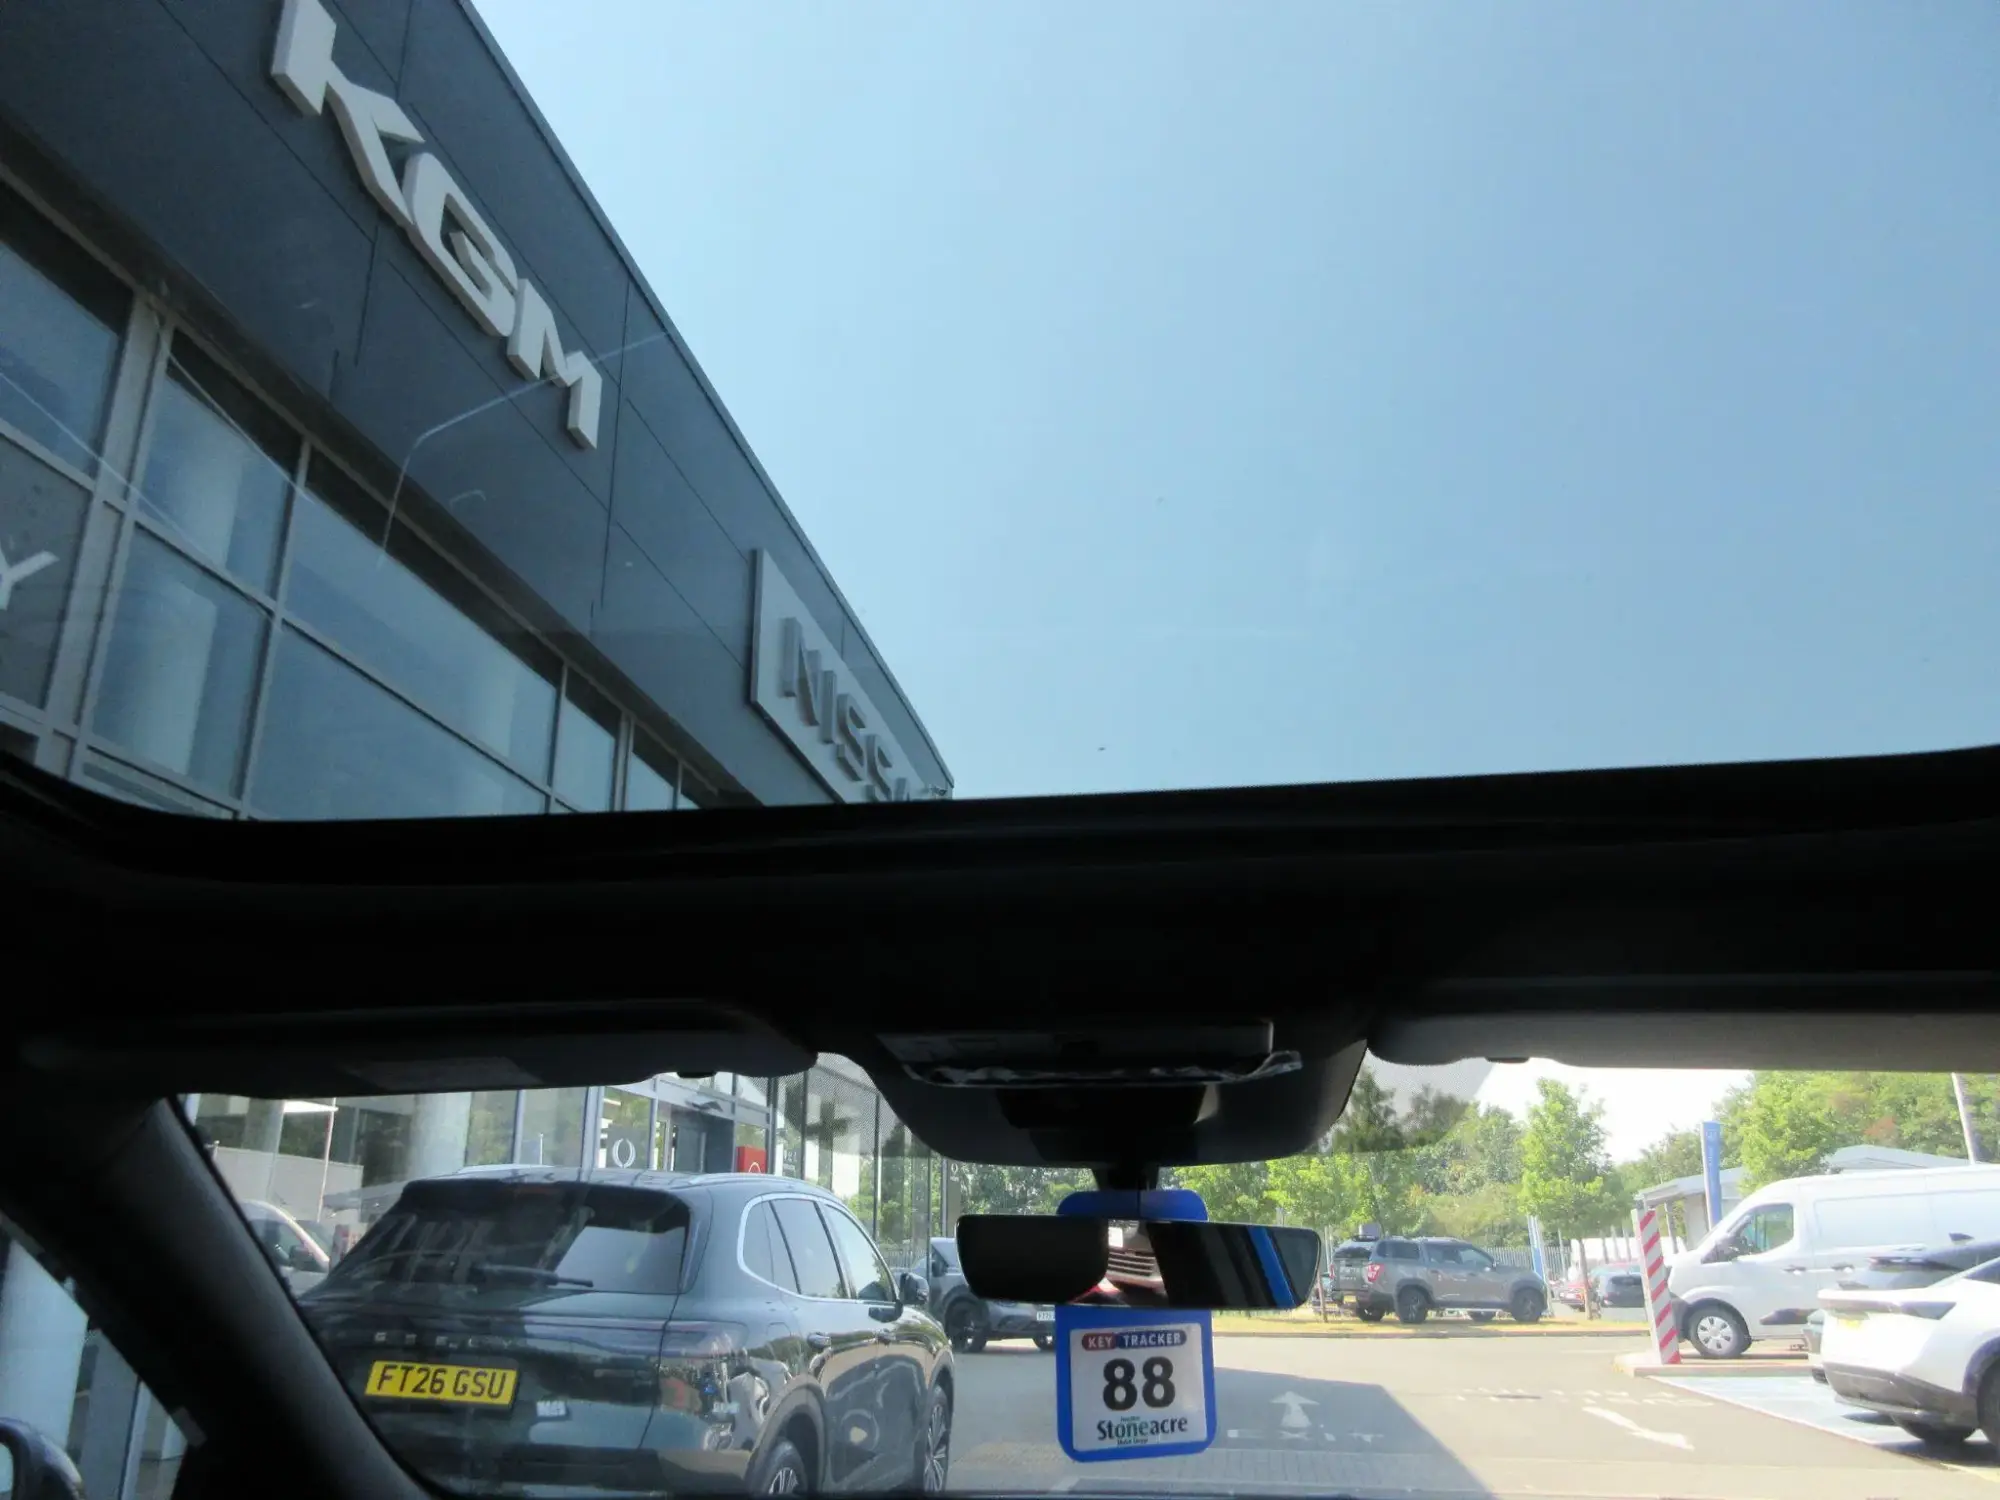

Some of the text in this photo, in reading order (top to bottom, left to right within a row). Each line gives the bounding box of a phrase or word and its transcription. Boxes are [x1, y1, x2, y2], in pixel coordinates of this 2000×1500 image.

[270, 0, 603, 450] KGM
[1088, 1332, 1182, 1348] KEY TRACKER
[376, 1363, 507, 1400] FT26 GSU
[1102, 1356, 1176, 1411] 88
[1096, 1417, 1188, 1441] Stoneacre
